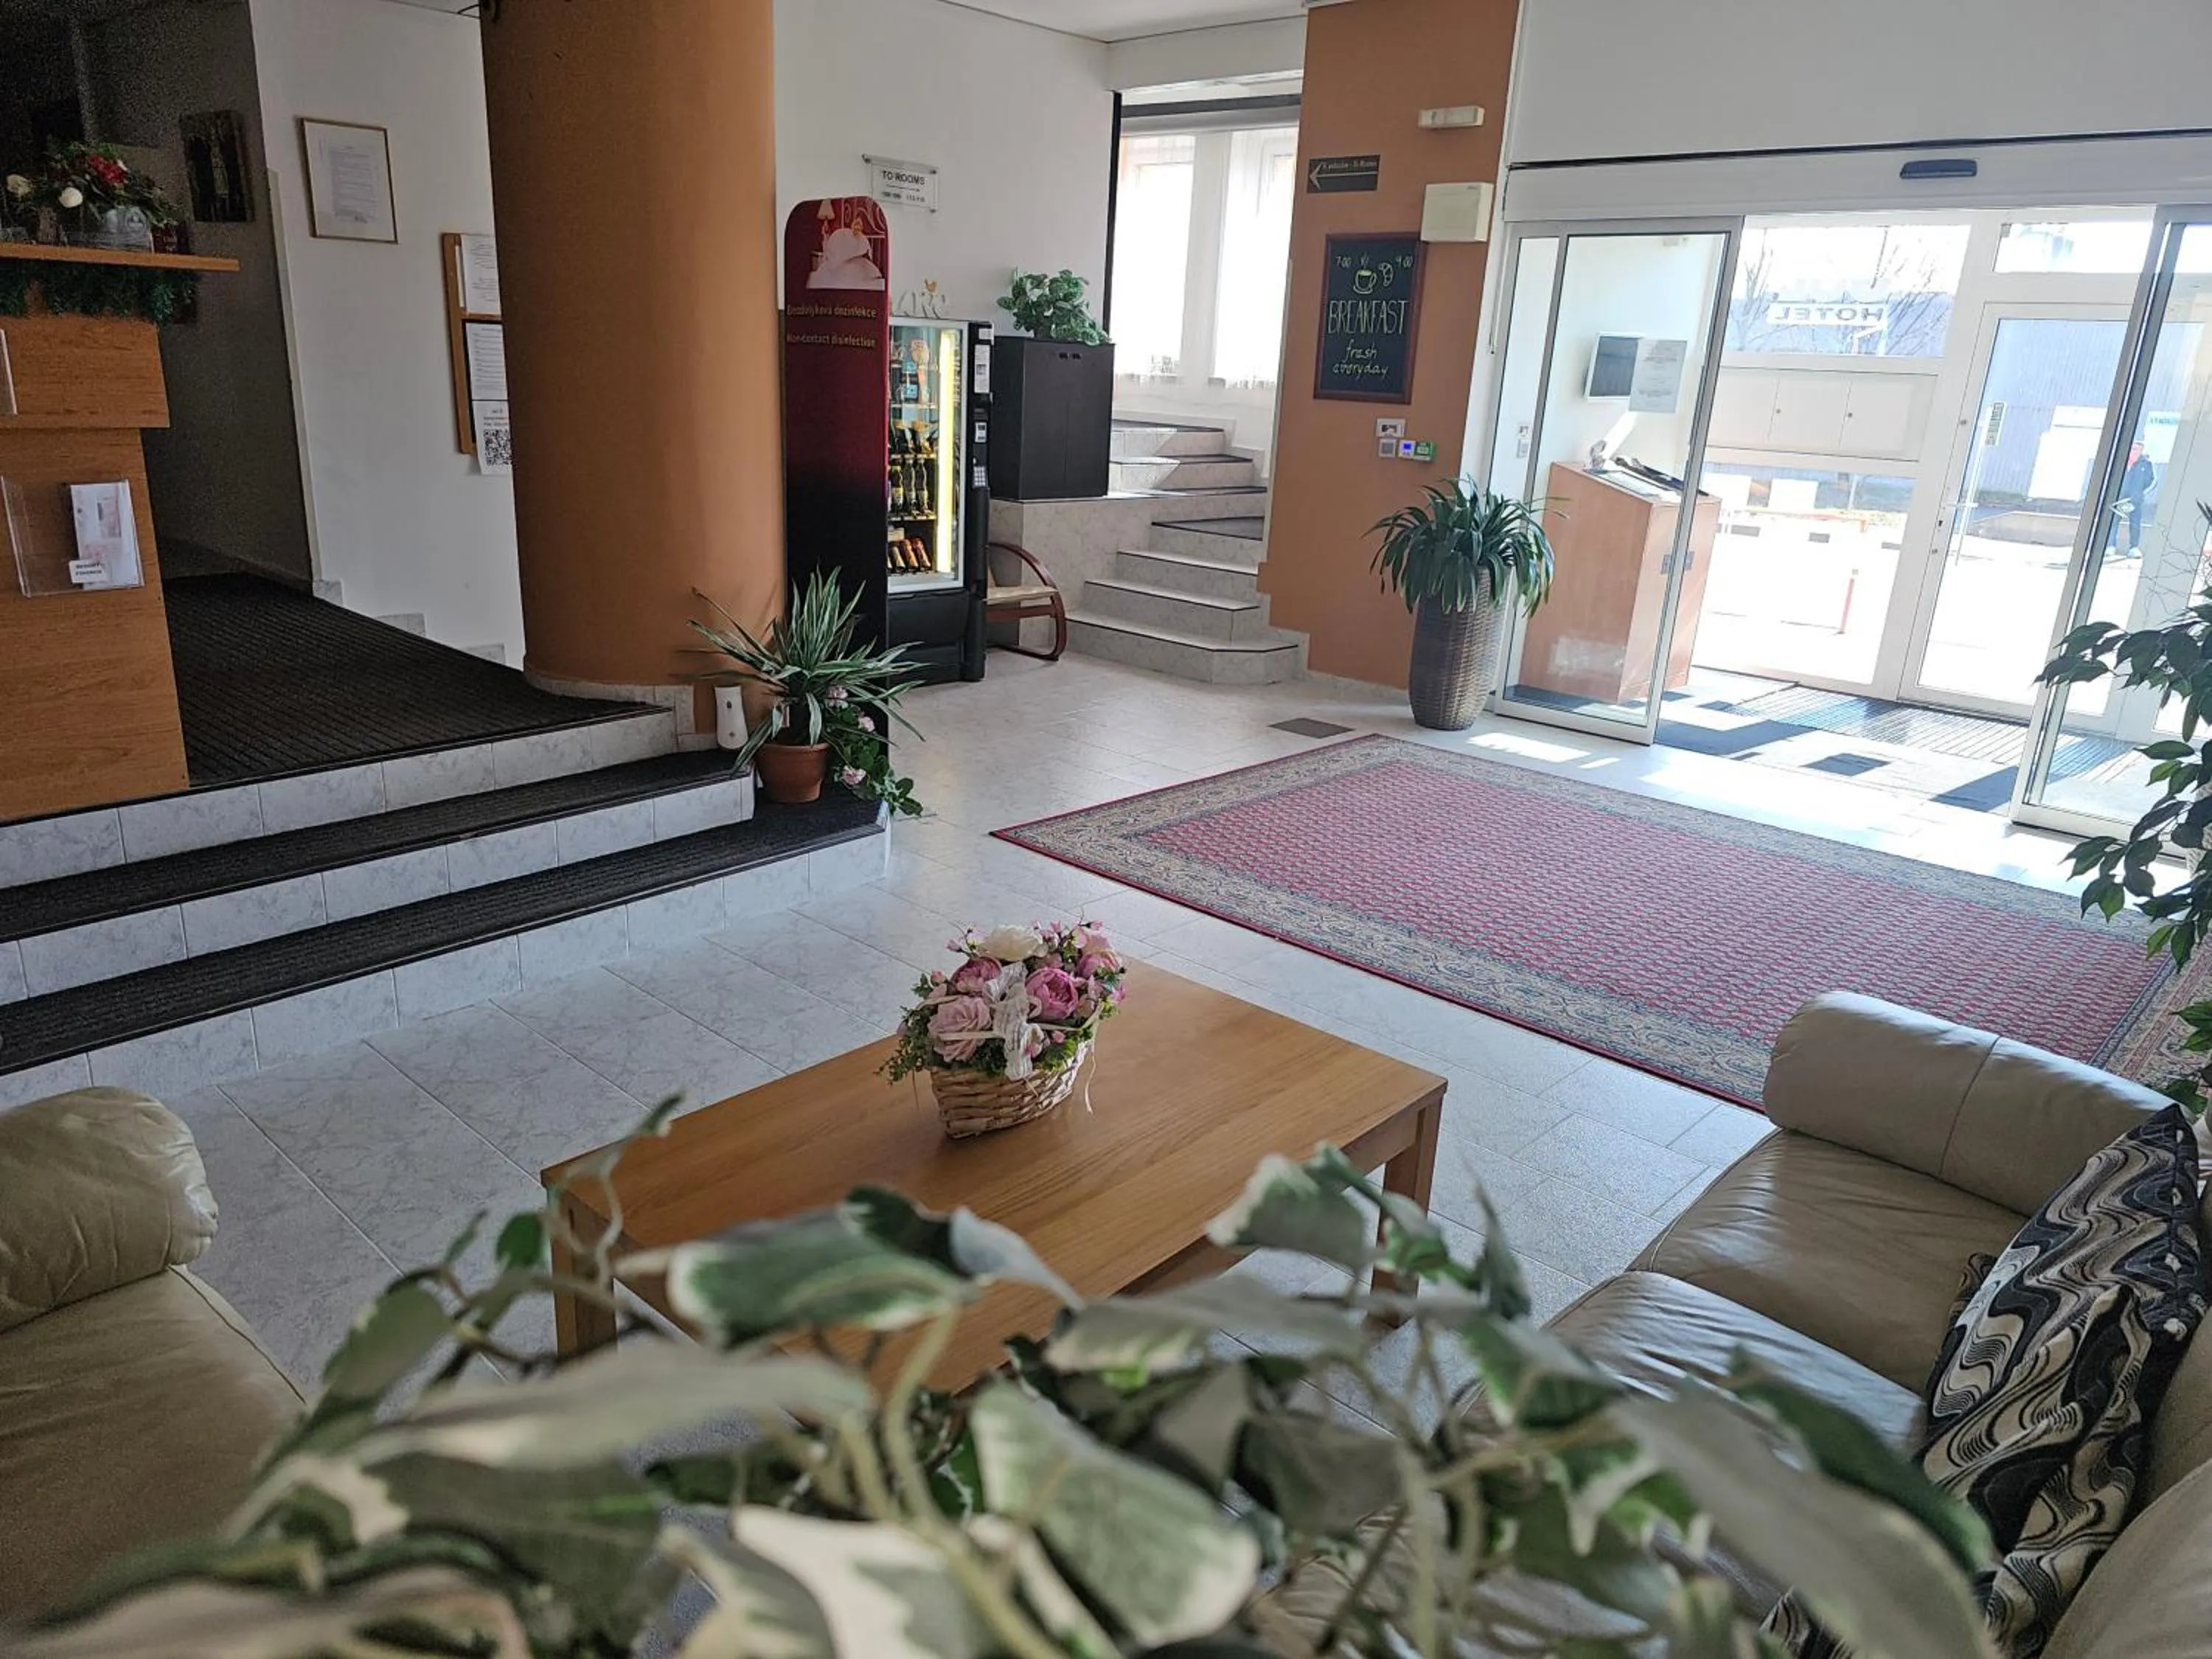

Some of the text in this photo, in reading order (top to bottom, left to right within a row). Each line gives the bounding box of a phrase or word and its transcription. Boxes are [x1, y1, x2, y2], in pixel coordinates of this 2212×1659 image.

[883, 170, 925, 187] TO ROOMS
[1328, 300, 1409, 335] BREAKFAST
[1342, 338, 1378, 364] fresh
[1332, 361, 1389, 380] everyday
